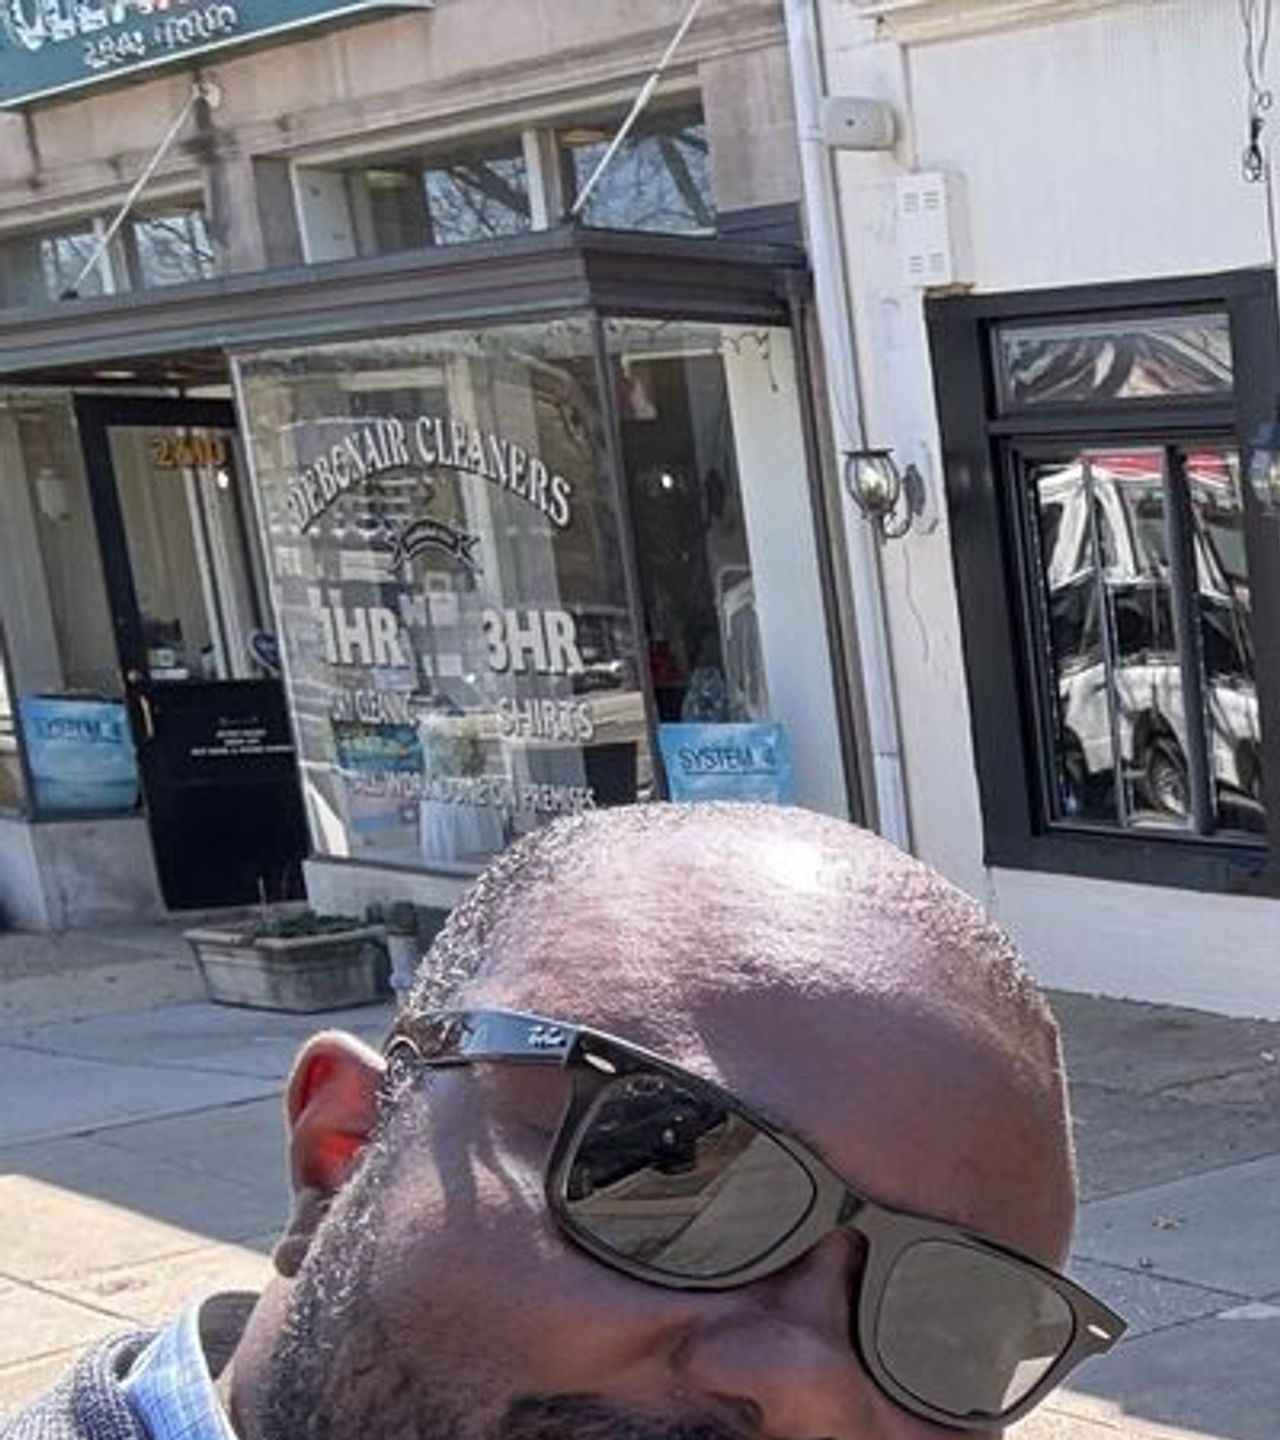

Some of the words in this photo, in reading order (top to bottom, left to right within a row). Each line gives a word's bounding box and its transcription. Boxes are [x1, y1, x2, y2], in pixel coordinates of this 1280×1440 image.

[415, 415, 571, 526] CLEANERS
[482, 609, 584, 673] 3HR
[679, 743, 754, 770] SYSTEM
